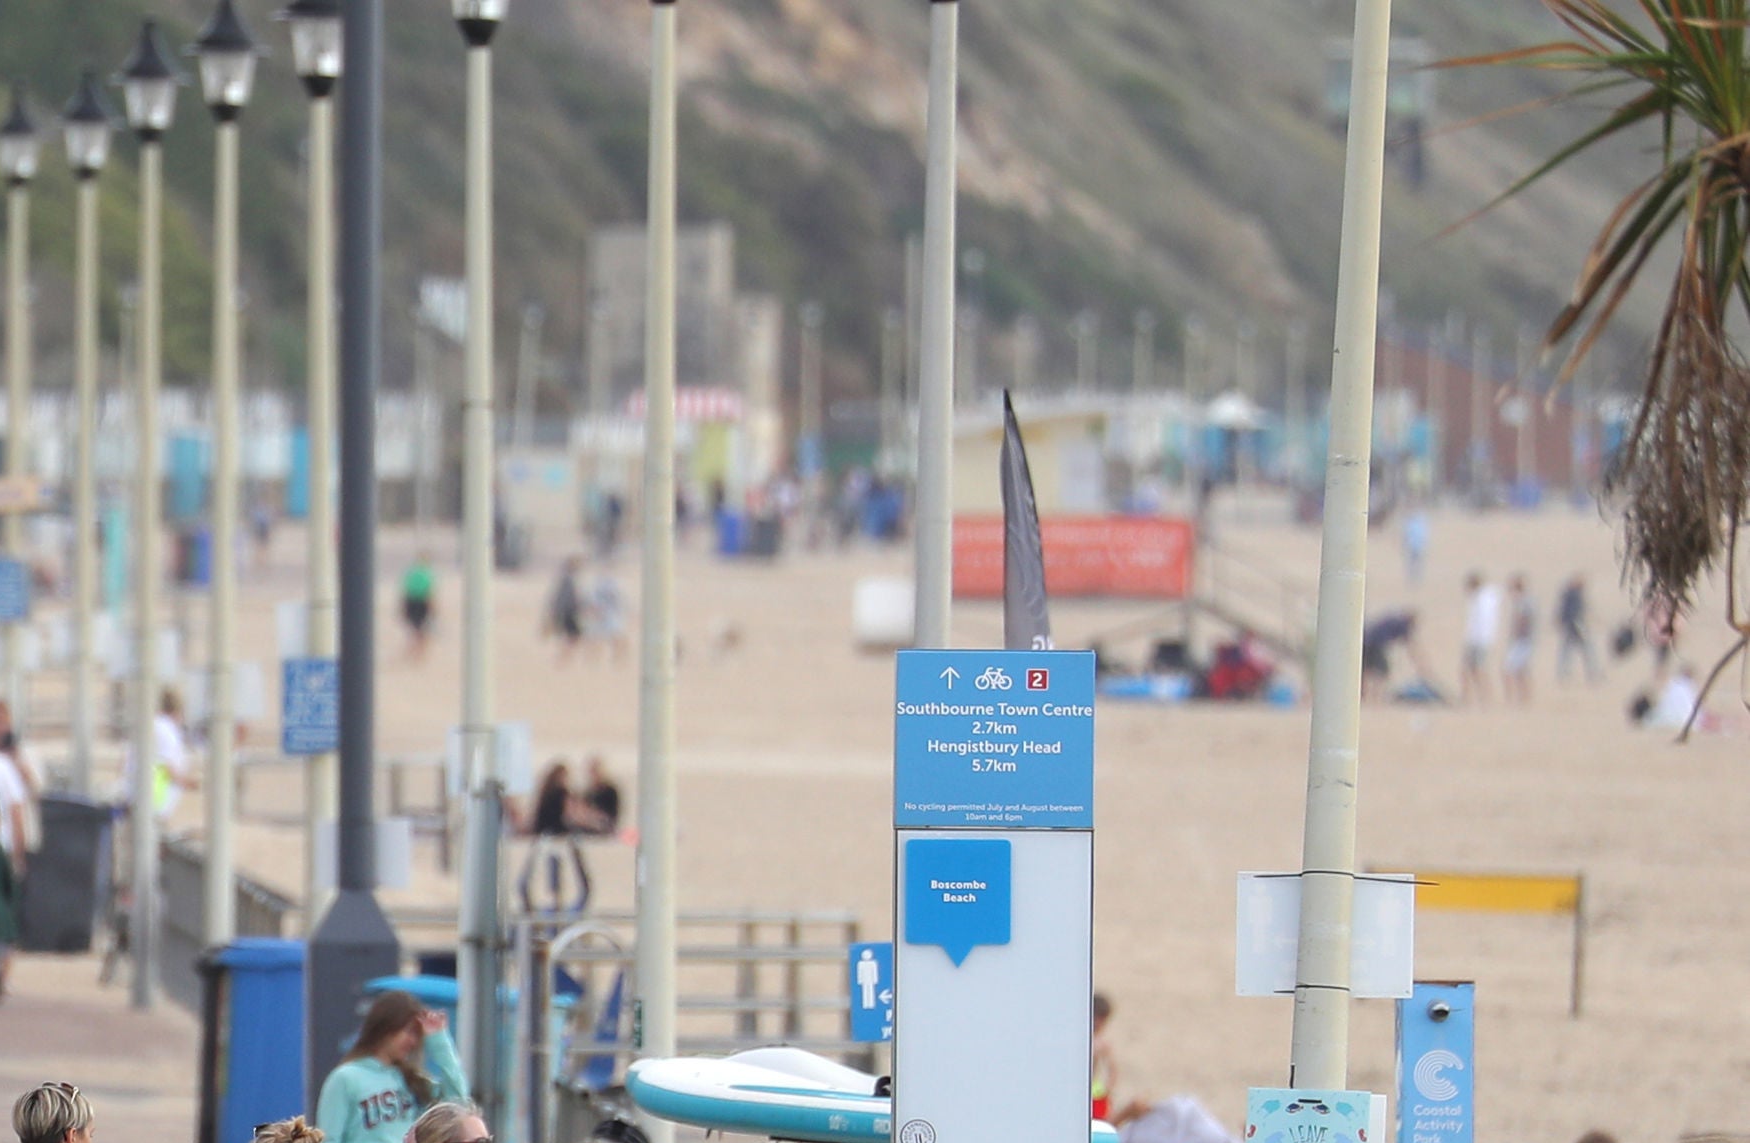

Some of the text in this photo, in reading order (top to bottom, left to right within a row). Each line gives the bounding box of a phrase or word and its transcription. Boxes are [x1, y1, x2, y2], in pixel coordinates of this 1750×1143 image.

[1032, 672, 1043, 687] 2
[897, 702, 1092, 717] Southbourne Town Centre
[972, 721, 1017, 735] 2.7km
[927, 739, 1061, 756] Hengistbury Head
[972, 759, 1017, 772] 5.7km
[904, 803, 1083, 813] No cycling permitted July and August between
[965, 813, 986, 821] 10am
[988, 813, 1003, 821] and
[930, 880, 987, 890] Boscombe
[943, 893, 976, 903] Beach
[1413, 1104, 1462, 1116] Coastal
[1414, 1120, 1463, 1134] Activity
